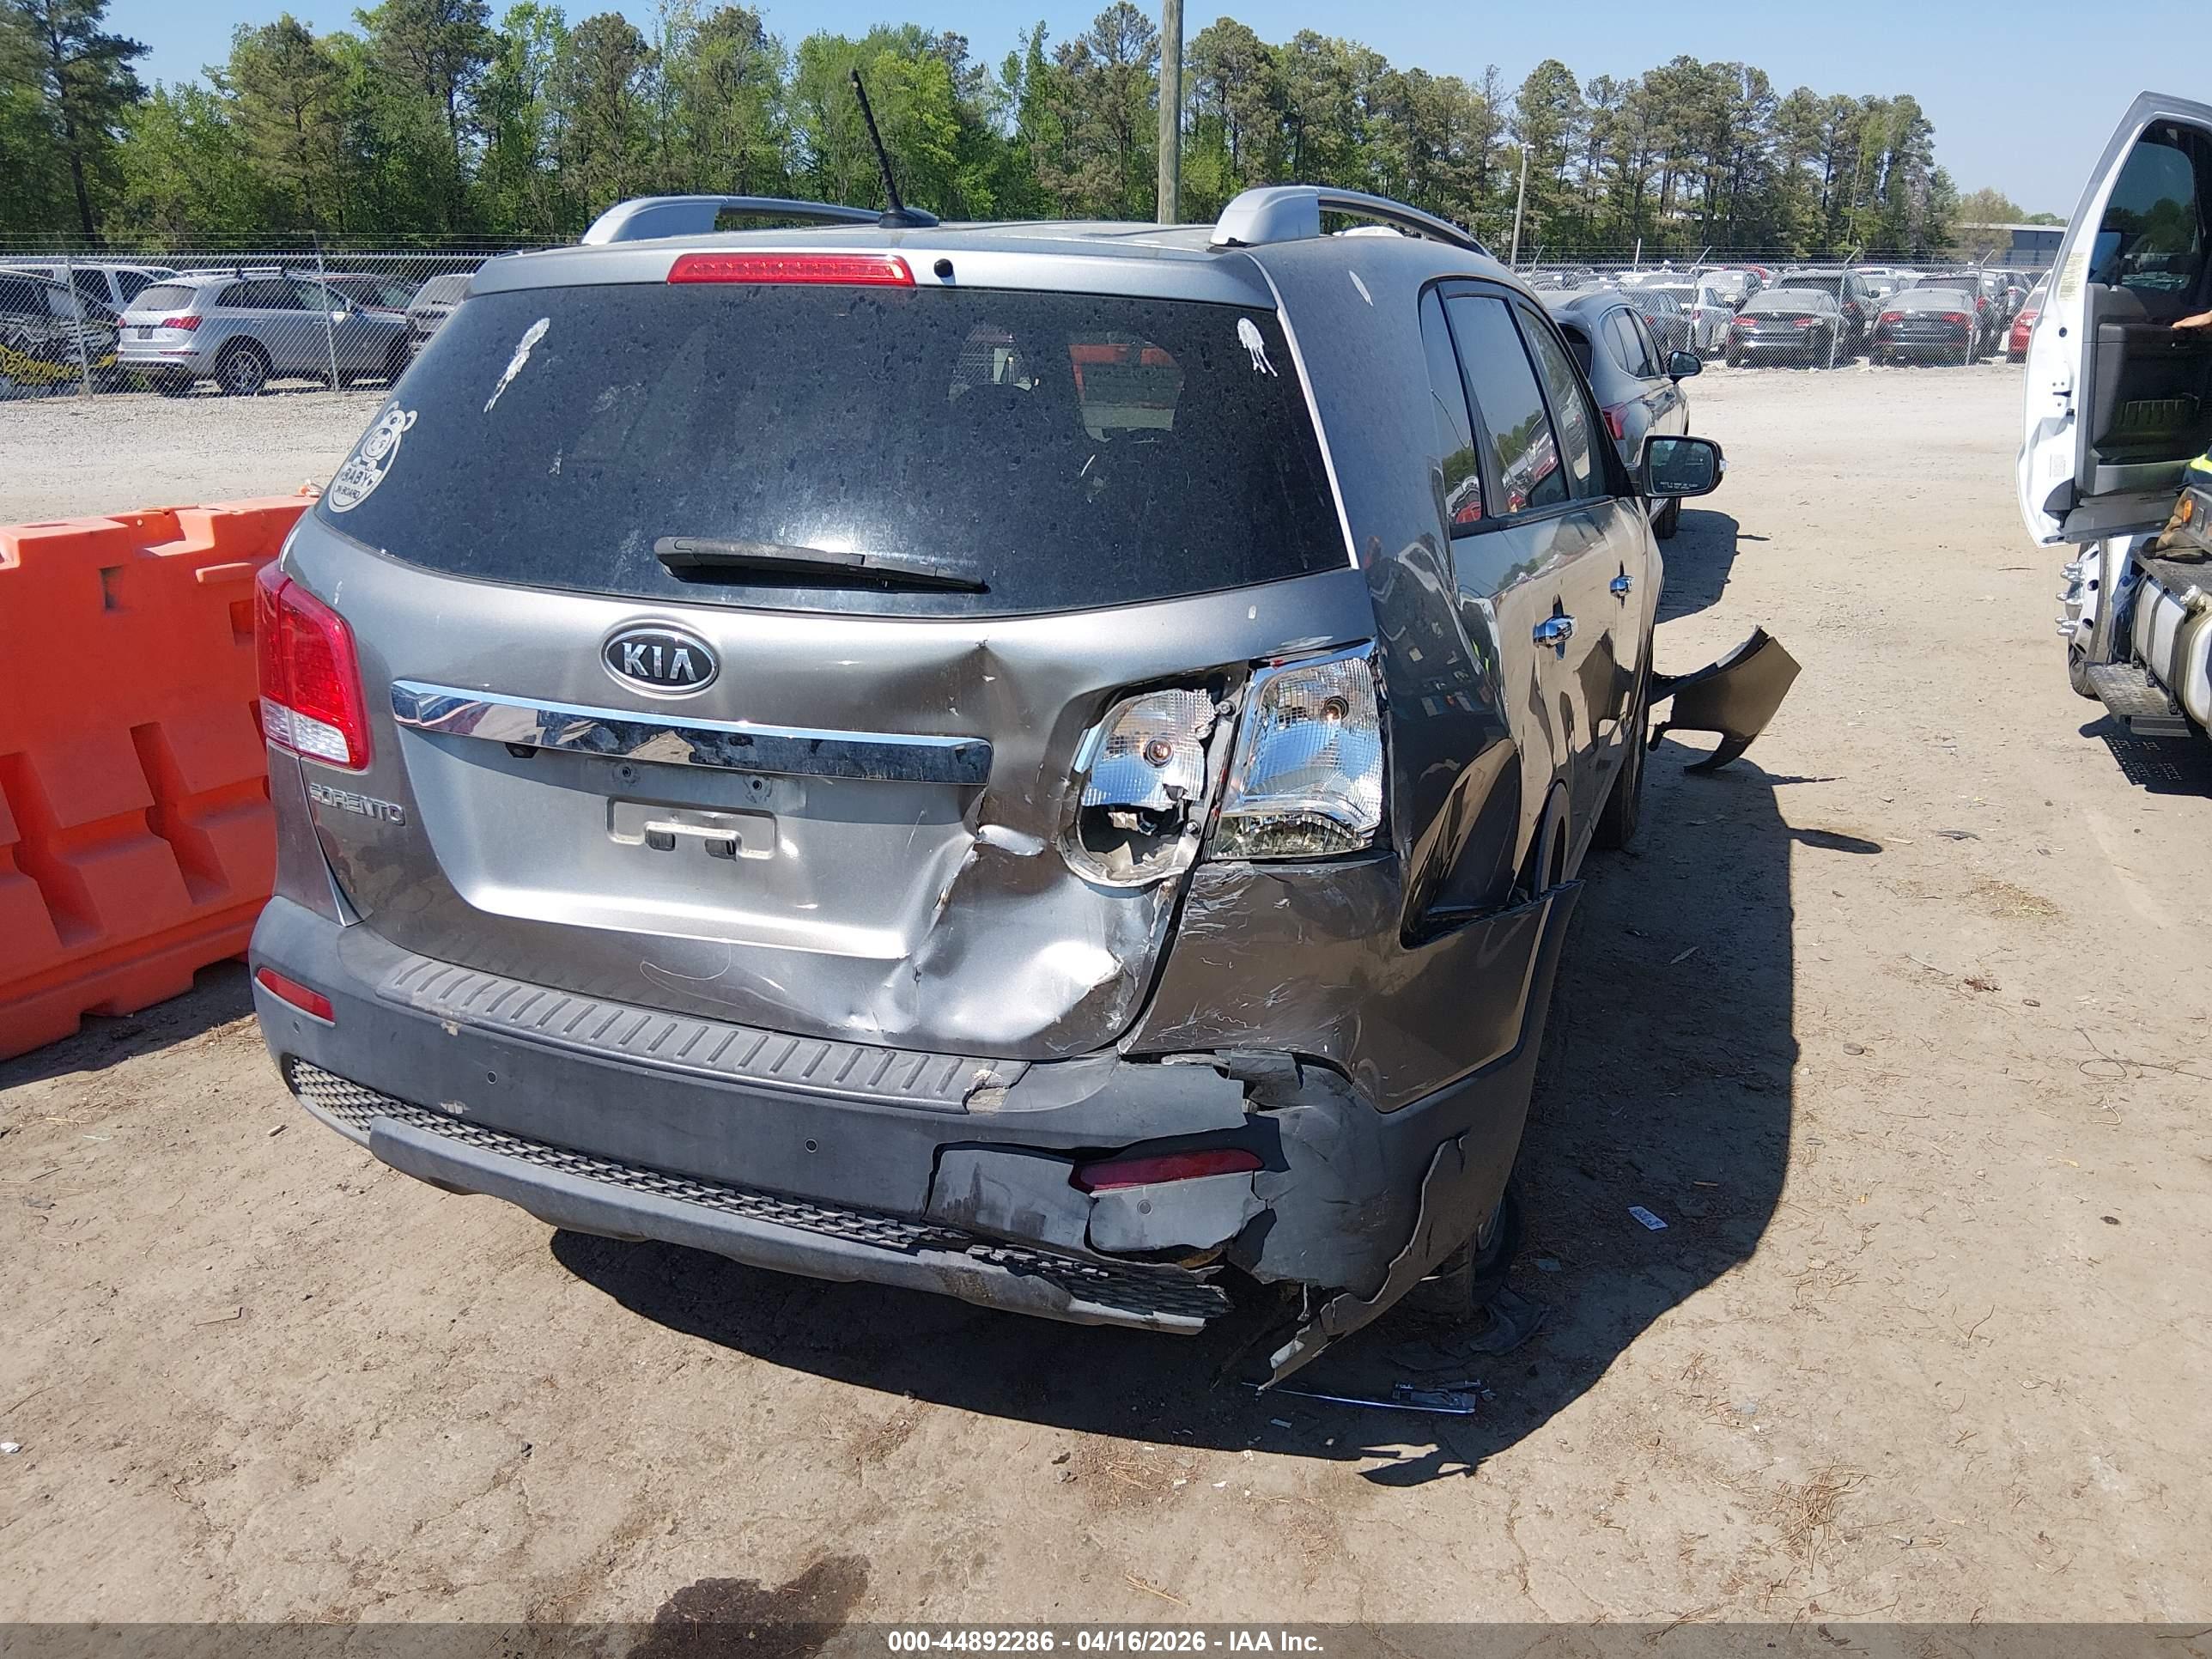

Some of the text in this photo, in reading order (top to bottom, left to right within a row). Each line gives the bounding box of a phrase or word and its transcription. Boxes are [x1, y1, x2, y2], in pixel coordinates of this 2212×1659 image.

[340, 467, 373, 487] BABY
[341, 486, 361, 499] BOARD
[622, 641, 698, 682] KIA
[309, 782, 406, 826] SORENTO
